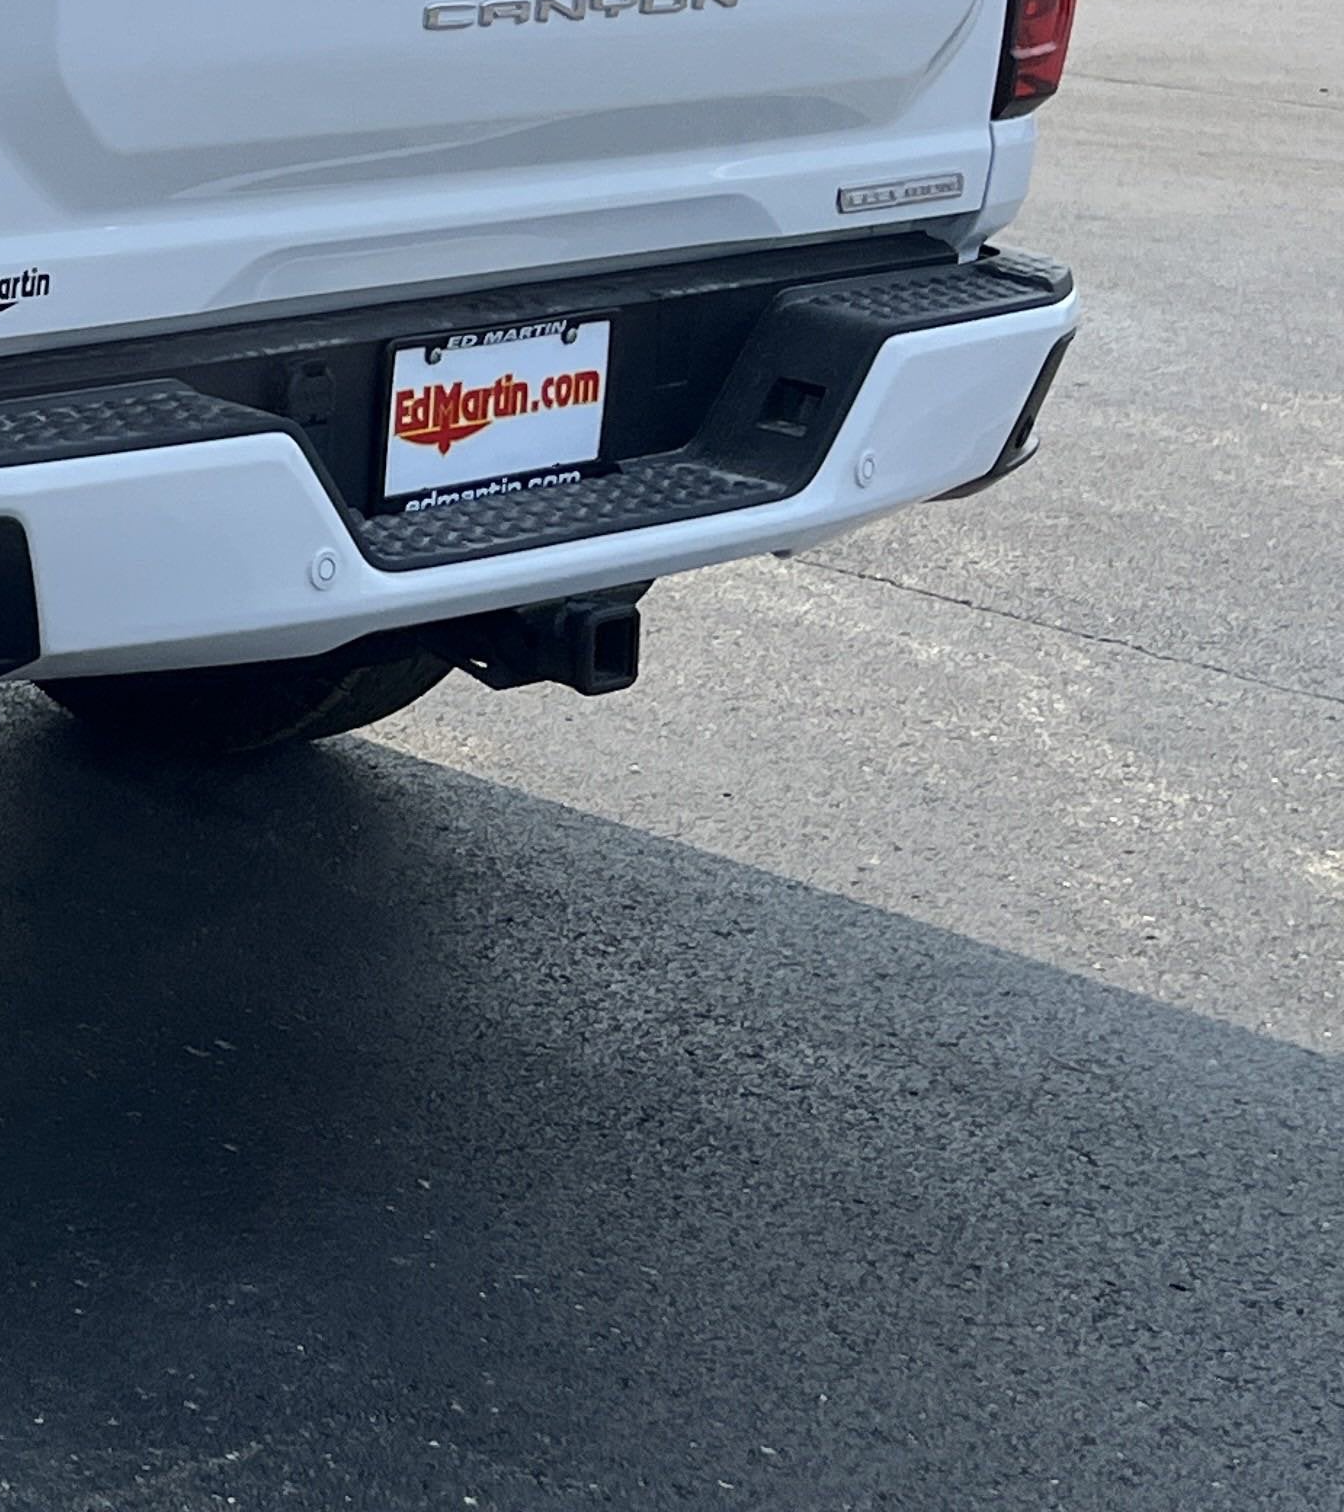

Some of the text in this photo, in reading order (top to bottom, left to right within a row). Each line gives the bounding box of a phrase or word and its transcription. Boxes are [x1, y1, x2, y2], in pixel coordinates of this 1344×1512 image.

[446, 320, 568, 350] ED MARTIN
[393, 370, 601, 438] EdMartin.com
[404, 470, 582, 512] edmartincom
